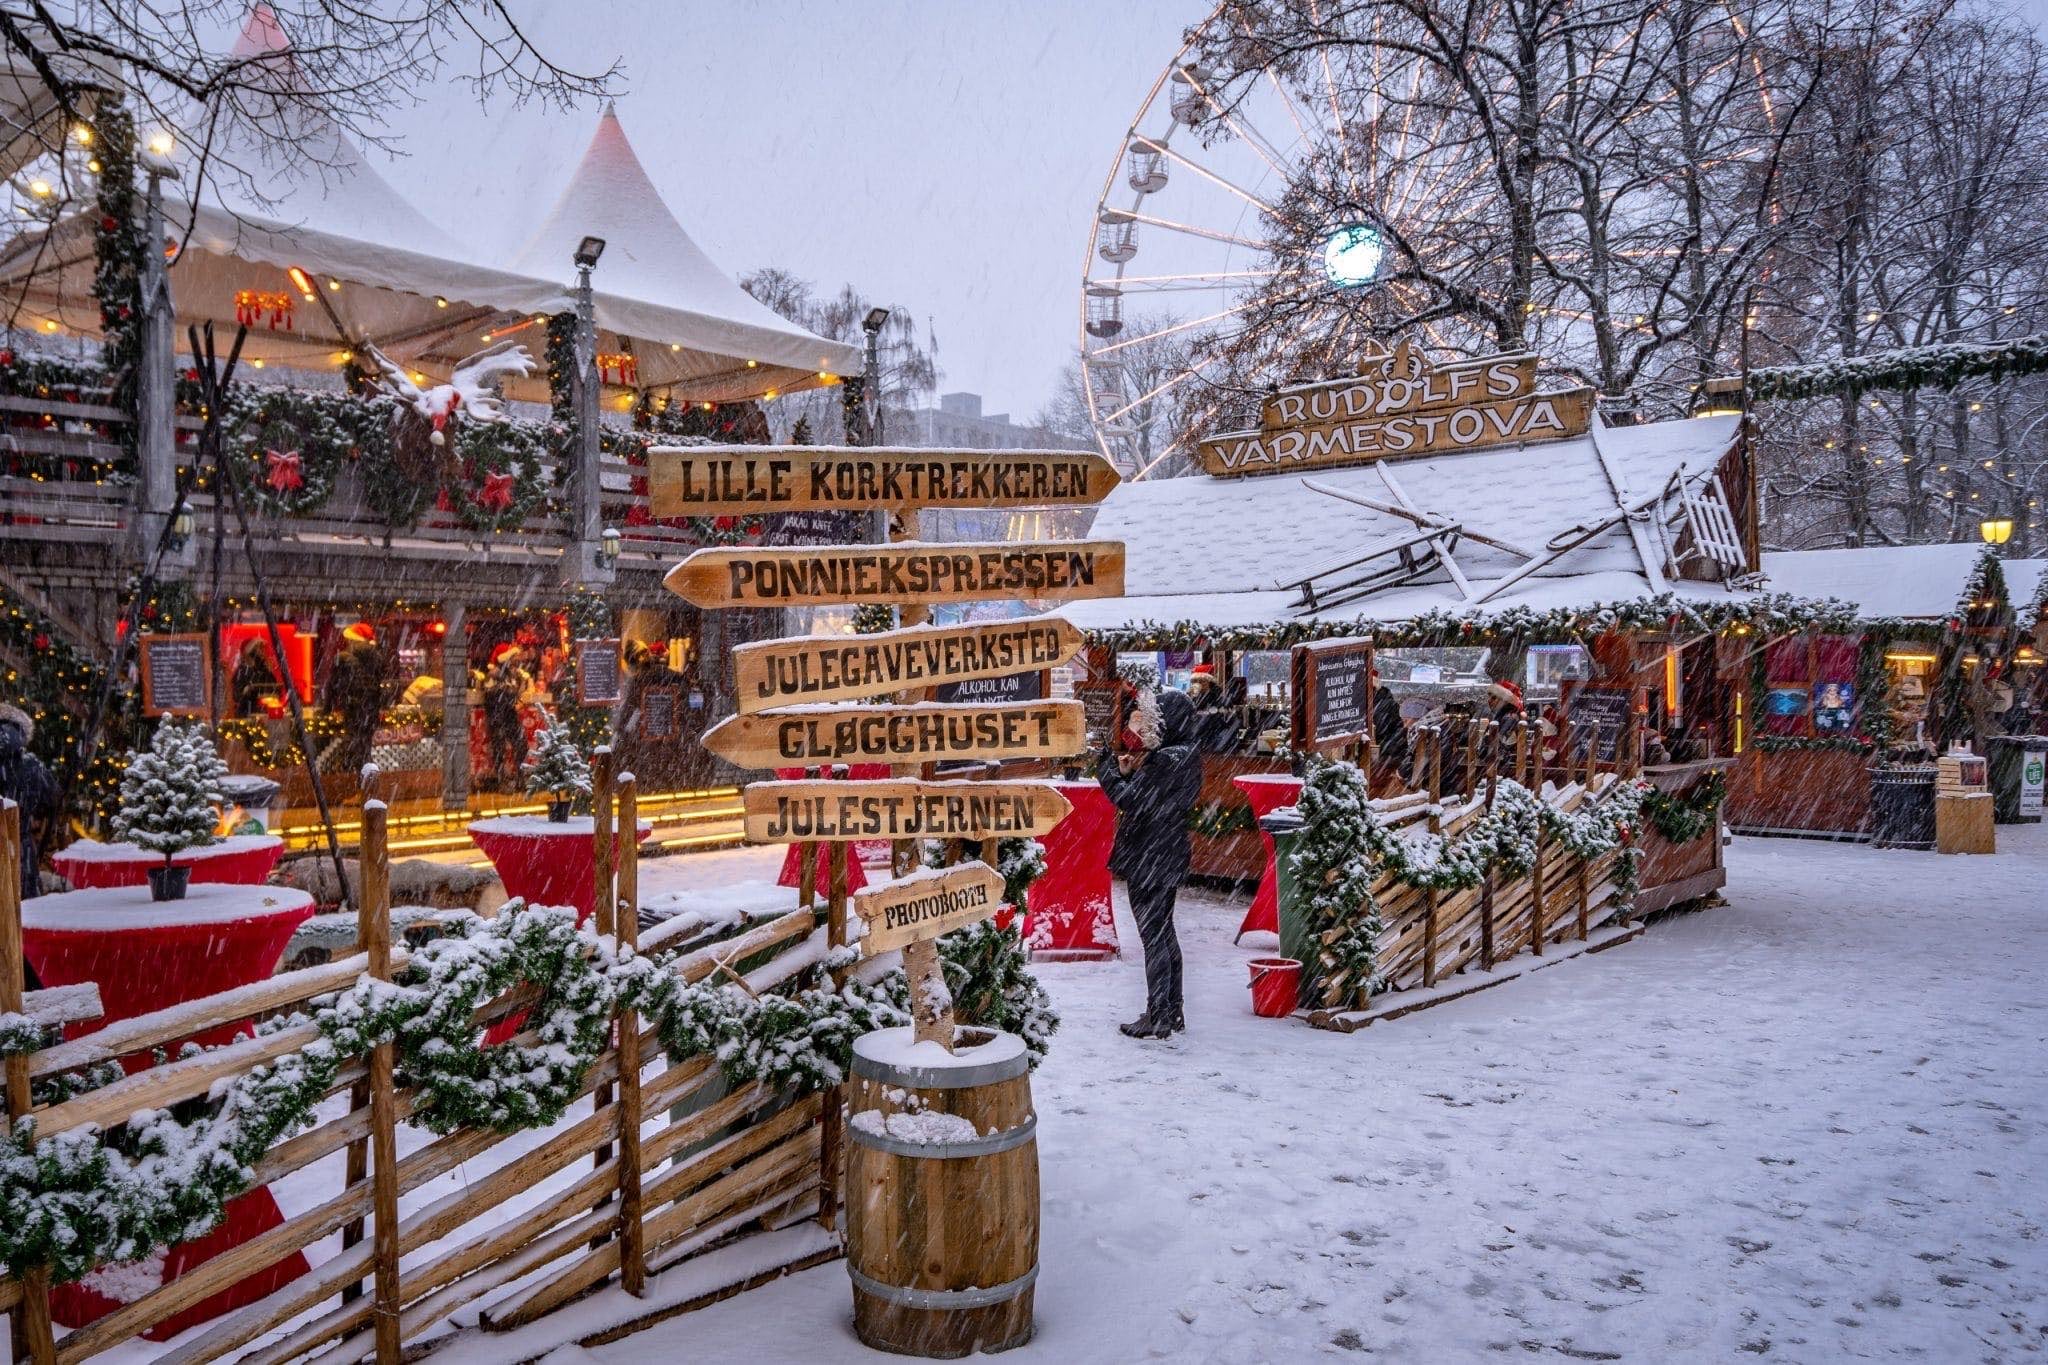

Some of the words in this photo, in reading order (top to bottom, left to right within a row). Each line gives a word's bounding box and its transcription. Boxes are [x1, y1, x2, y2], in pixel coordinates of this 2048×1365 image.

[1271, 363, 1520, 424] RUDOLFS
[1214, 401, 1565, 468] VARMESTOVA
[681, 460, 791, 502] LILLE
[810, 461, 1089, 501] KORKTREKKEREN
[729, 552, 1095, 598] PONNIEKSPRESSEN
[758, 628, 1061, 698] JULEGAVEVERKSTED
[958, 680, 997, 695] ALKOHOL
[1001, 678, 1018, 691] KAN
[778, 710, 1057, 759] GLØGGHUSET
[767, 795, 1034, 837] JULESTJERNEN
[884, 884, 988, 930] PHOTOBOOTH
